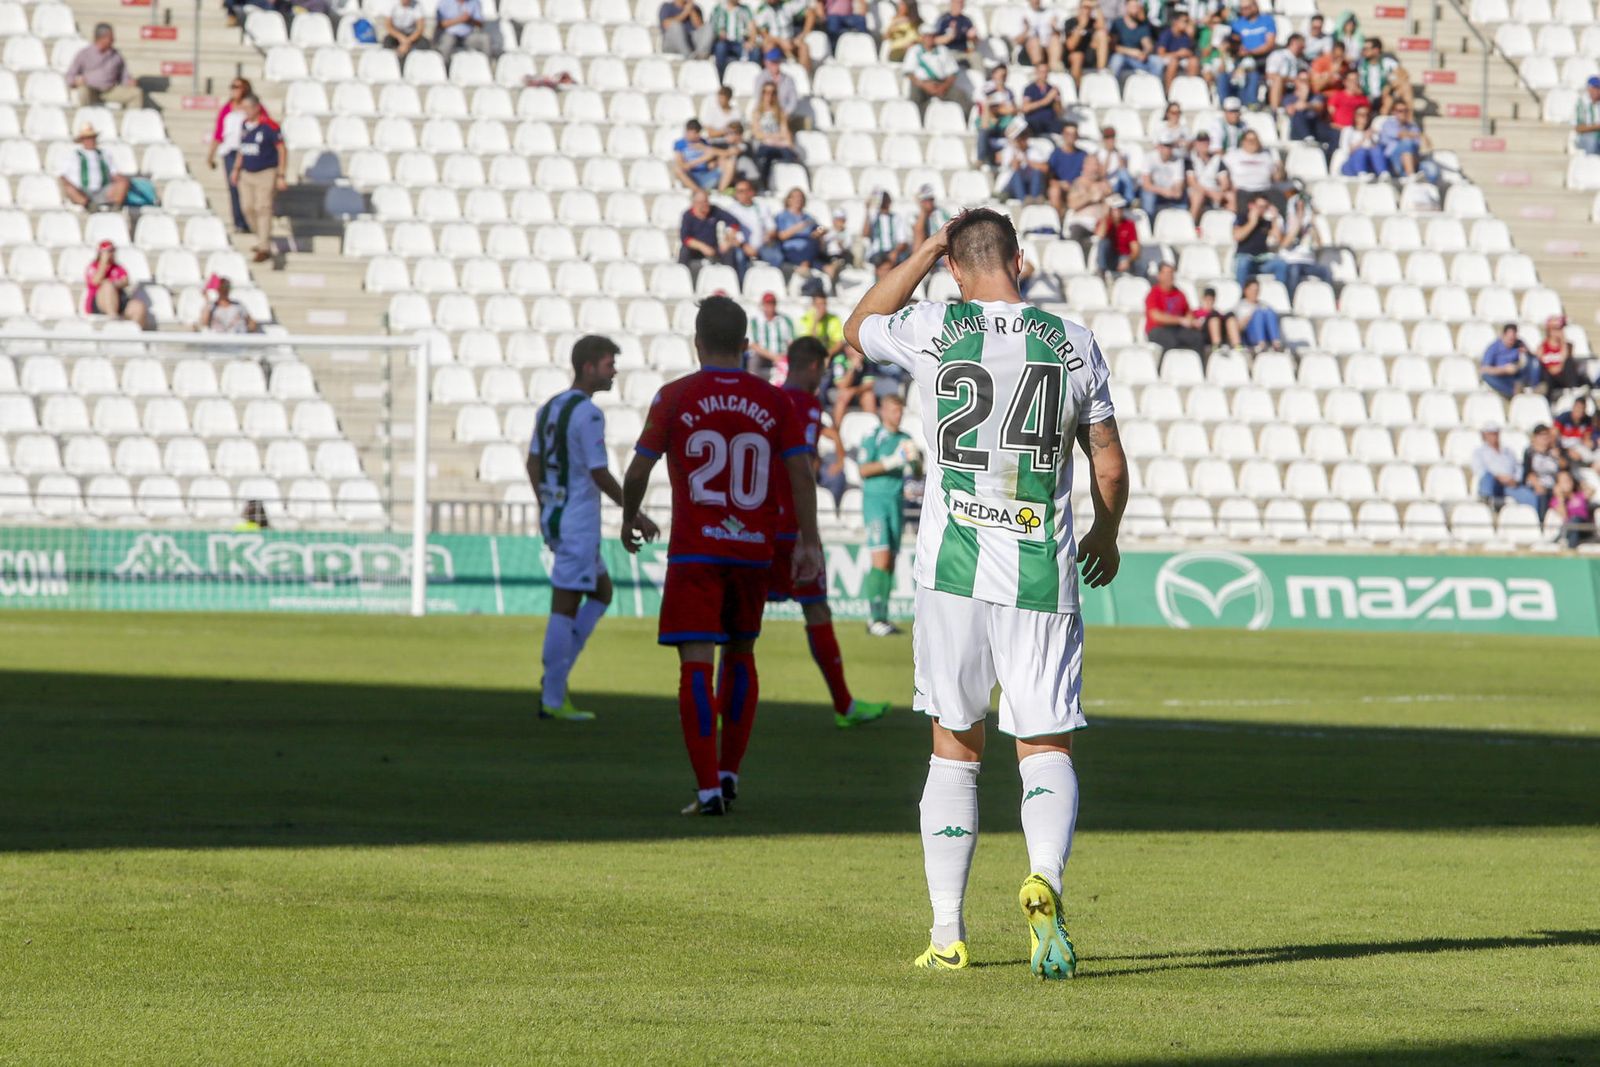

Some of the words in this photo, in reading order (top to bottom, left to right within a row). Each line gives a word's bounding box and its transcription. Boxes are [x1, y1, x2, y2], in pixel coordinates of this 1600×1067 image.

[921, 315, 989, 363] JAIME
[995, 316, 1085, 373] ROMERO
[680, 411, 701, 428] P.
[698, 394, 777, 432] VALCARCE
[935, 359, 1065, 472] 24
[685, 429, 772, 511] 20
[207, 533, 454, 590] Kappa
